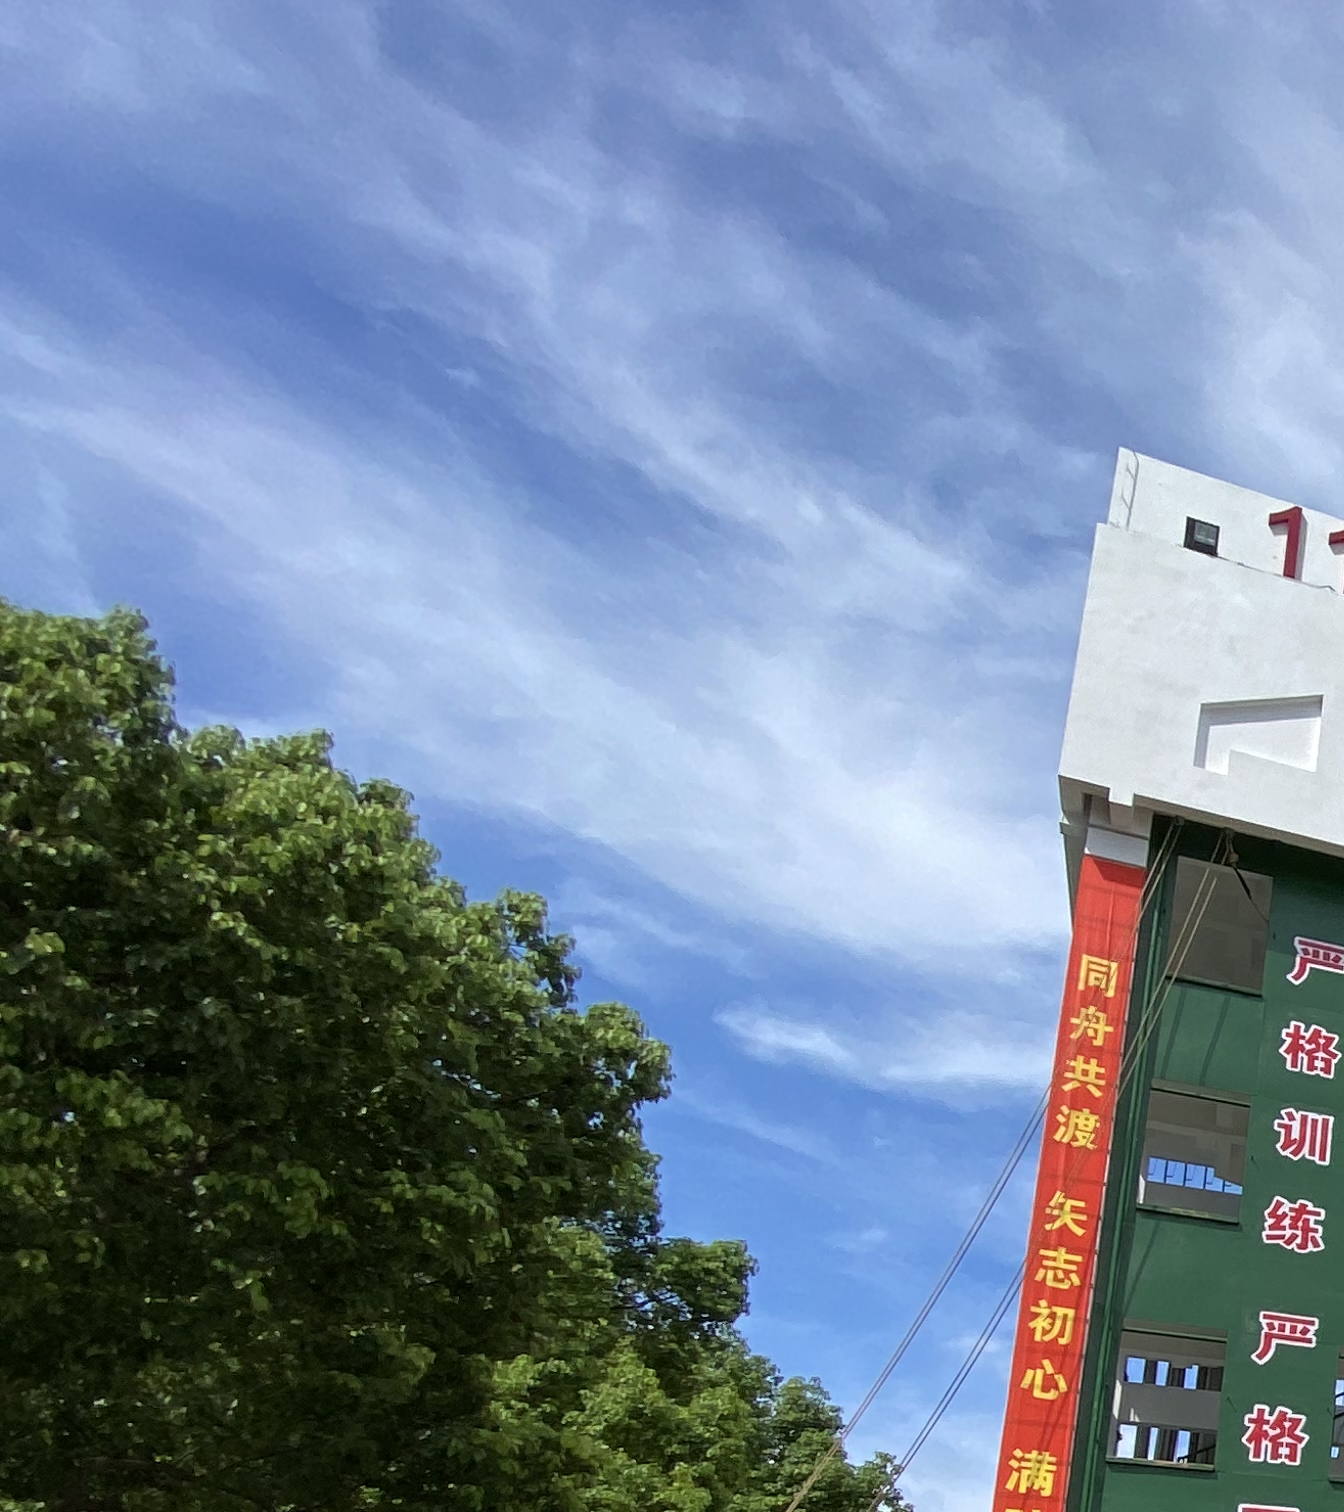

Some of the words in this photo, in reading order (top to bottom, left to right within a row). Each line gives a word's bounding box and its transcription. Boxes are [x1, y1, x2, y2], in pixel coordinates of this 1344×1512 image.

[1053, 954, 1118, 1150] 同舟共渡
[1020, 1191, 1087, 1402] 矢志初心
